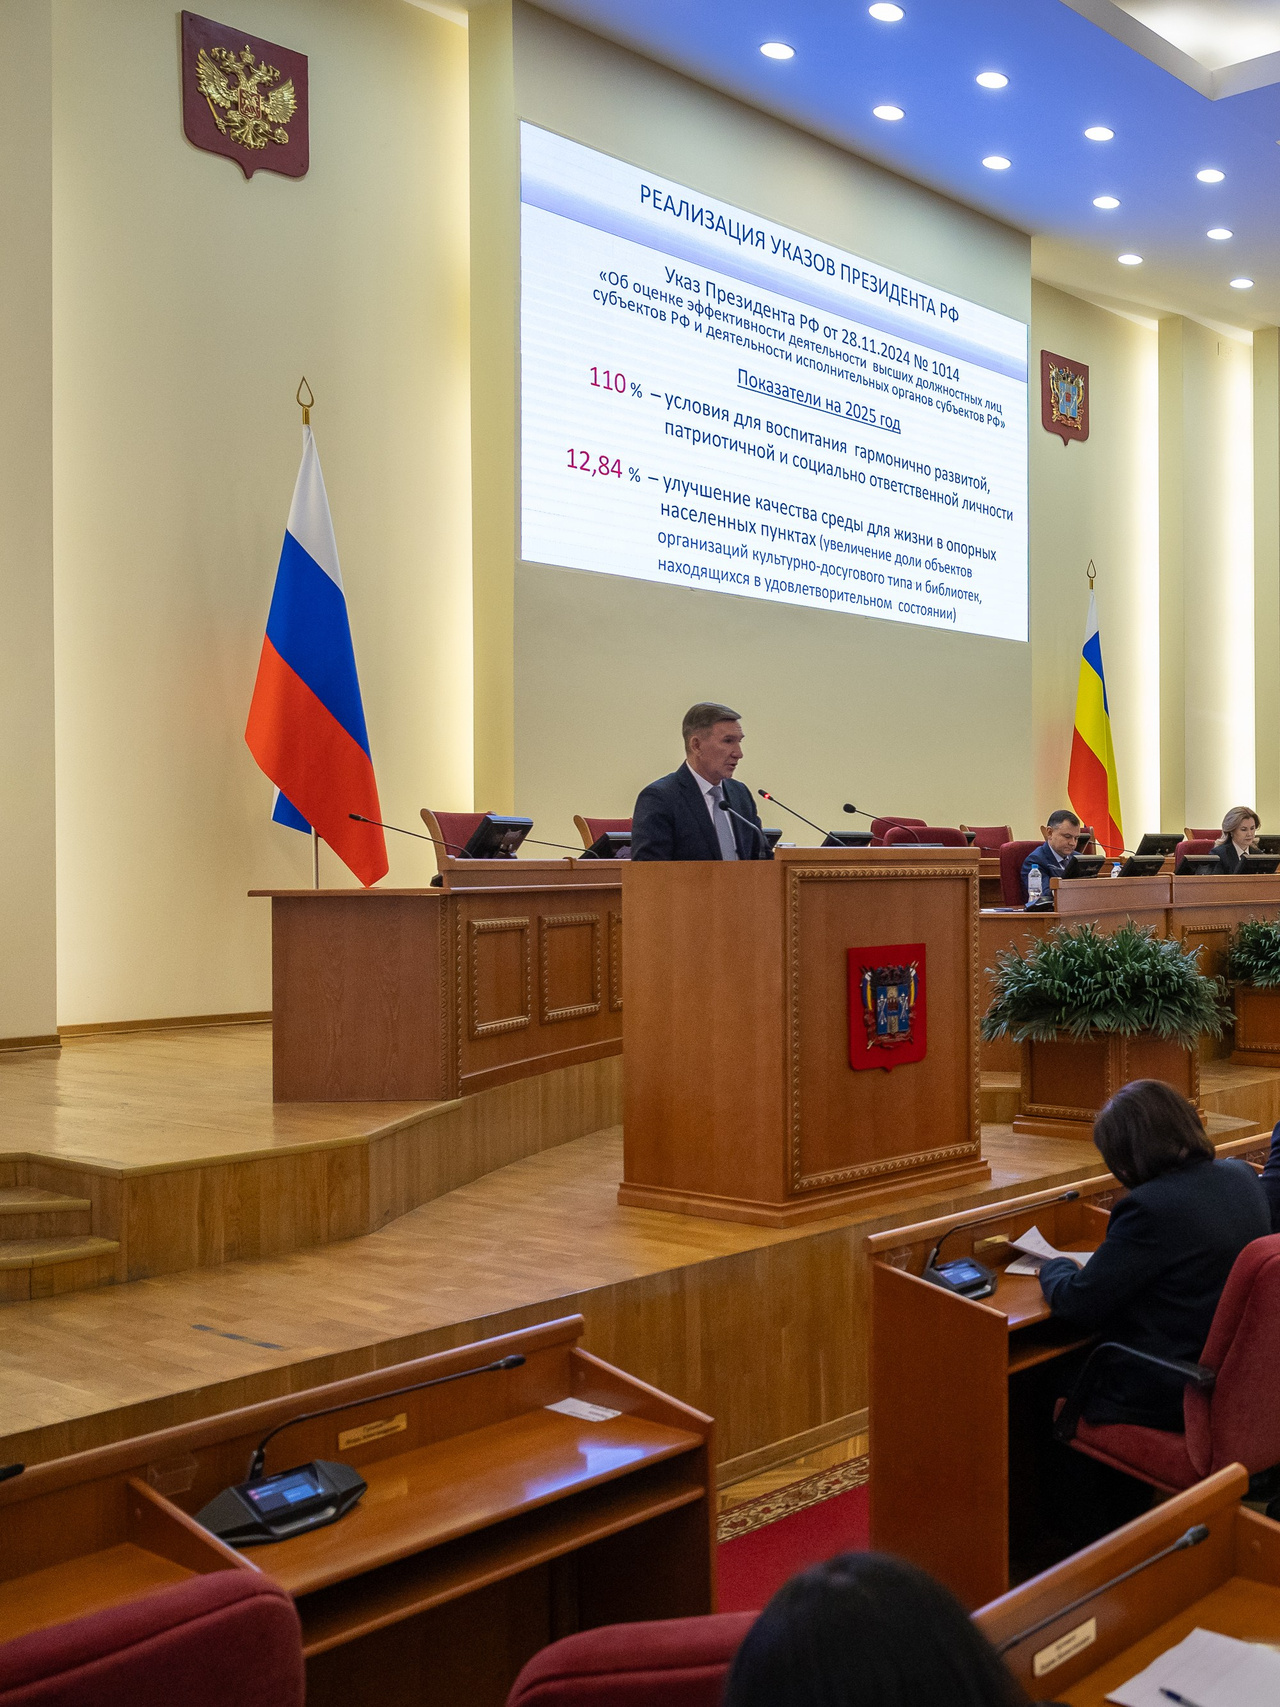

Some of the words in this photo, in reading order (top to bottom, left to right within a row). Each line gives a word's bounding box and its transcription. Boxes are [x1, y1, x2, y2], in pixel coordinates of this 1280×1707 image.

[640, 183, 766, 251] РЕАЛИЗАЦИЯ
[770, 234, 836, 277] УКАЗОВ
[840, 262, 937, 316] ПРЕЗИДЕНТА
[940, 302, 960, 324] РФ
[592, 288, 667, 322] субъектов
[671, 310, 691, 329] РФ
[694, 320, 703, 334] и
[705, 325, 793, 363] деятельности
[795, 353, 890, 394] исполнительных
[891, 385, 934, 407] органов
[935, 399, 985, 424] субъектов
[986, 413, 1006, 429] РФ»
[599, 270, 629, 290] «Об
[632, 282, 684, 308] оценке
[686, 298, 786, 342] эффективности
[788, 334, 867, 369] деятельности
[872, 362, 914, 385] высших
[915, 376, 983, 408] должностных
[984, 399, 1003, 416] лиц
[664, 265, 701, 294] Указ
[705, 280, 796, 327] Президента
[799, 313, 820, 334] РФ
[823, 325, 839, 341] от
[841, 328, 911, 366] 28.11.2024
[913, 353, 929, 372] №
[931, 360, 960, 383] 1014
[589, 366, 627, 394] 110
[629, 381, 643, 399] %
[664, 392, 730, 423] условия
[733, 412, 762, 431] для
[765, 420, 847, 454] воспитания
[854, 444, 932, 477] гармонично
[934, 467, 991, 495] развитой,
[737, 367, 822, 409] Показатели
[824, 397, 843, 413] на
[844, 400, 878, 423] 2025
[879, 414, 903, 434] год
[566, 447, 623, 479] 12,84
[628, 466, 641, 483] %
[662, 475, 751, 508] улучшение
[755, 496, 818, 522] качества
[821, 511, 864, 534] среды
[866, 522, 891, 538] для
[893, 528, 934, 548] жизни
[936, 537, 944, 550] в
[945, 539, 997, 562] опорных
[664, 421, 775, 462] патриотичной
[779, 451, 789, 465] и
[792, 454, 867, 485] социально
[869, 474, 959, 508] ответственной
[961, 498, 1014, 522] личности
[657, 531, 749, 560] организаций
[752, 549, 885, 585] культурно-досугового
[886, 575, 913, 590] типа
[915, 581, 923, 592] и
[924, 579, 983, 605] библиотек,
[658, 558, 750, 586] находящихся
[754, 575, 762, 588] в
[763, 577, 893, 610] удовлетворительном
[897, 601, 957, 624] состоянии)
[660, 502, 757, 535] населенных
[760, 523, 817, 547] пунктах
[819, 533, 892, 563] (увеличение
[893, 553, 922, 569] доли
[924, 557, 973, 579] объектов
